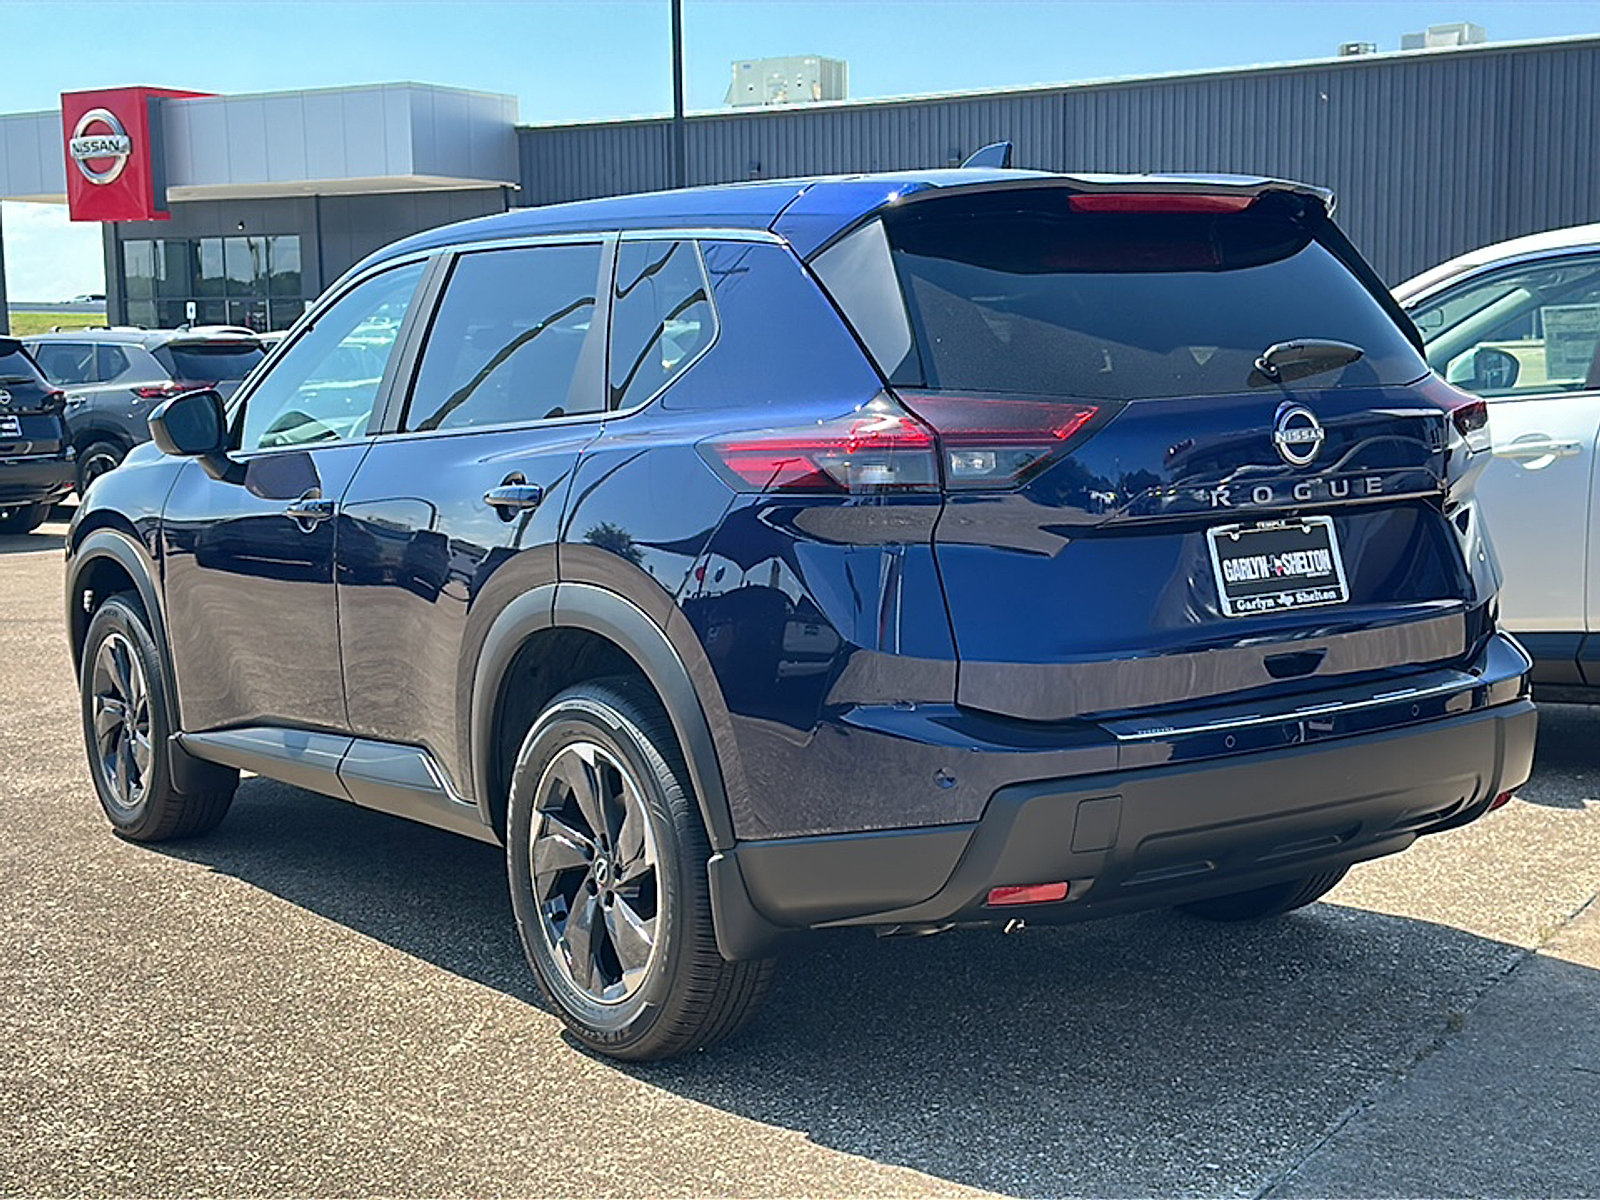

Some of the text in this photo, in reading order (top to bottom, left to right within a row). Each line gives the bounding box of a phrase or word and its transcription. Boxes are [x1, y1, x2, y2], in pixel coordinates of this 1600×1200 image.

[71, 139, 120, 152] NISSAN
[1276, 428, 1324, 443] NISSAN
[1210, 477, 1383, 507] ROGUE
[1223, 549, 1332, 582] GARLYN SHELTON
[1236, 590, 1337, 611] Garlyn Shelton
